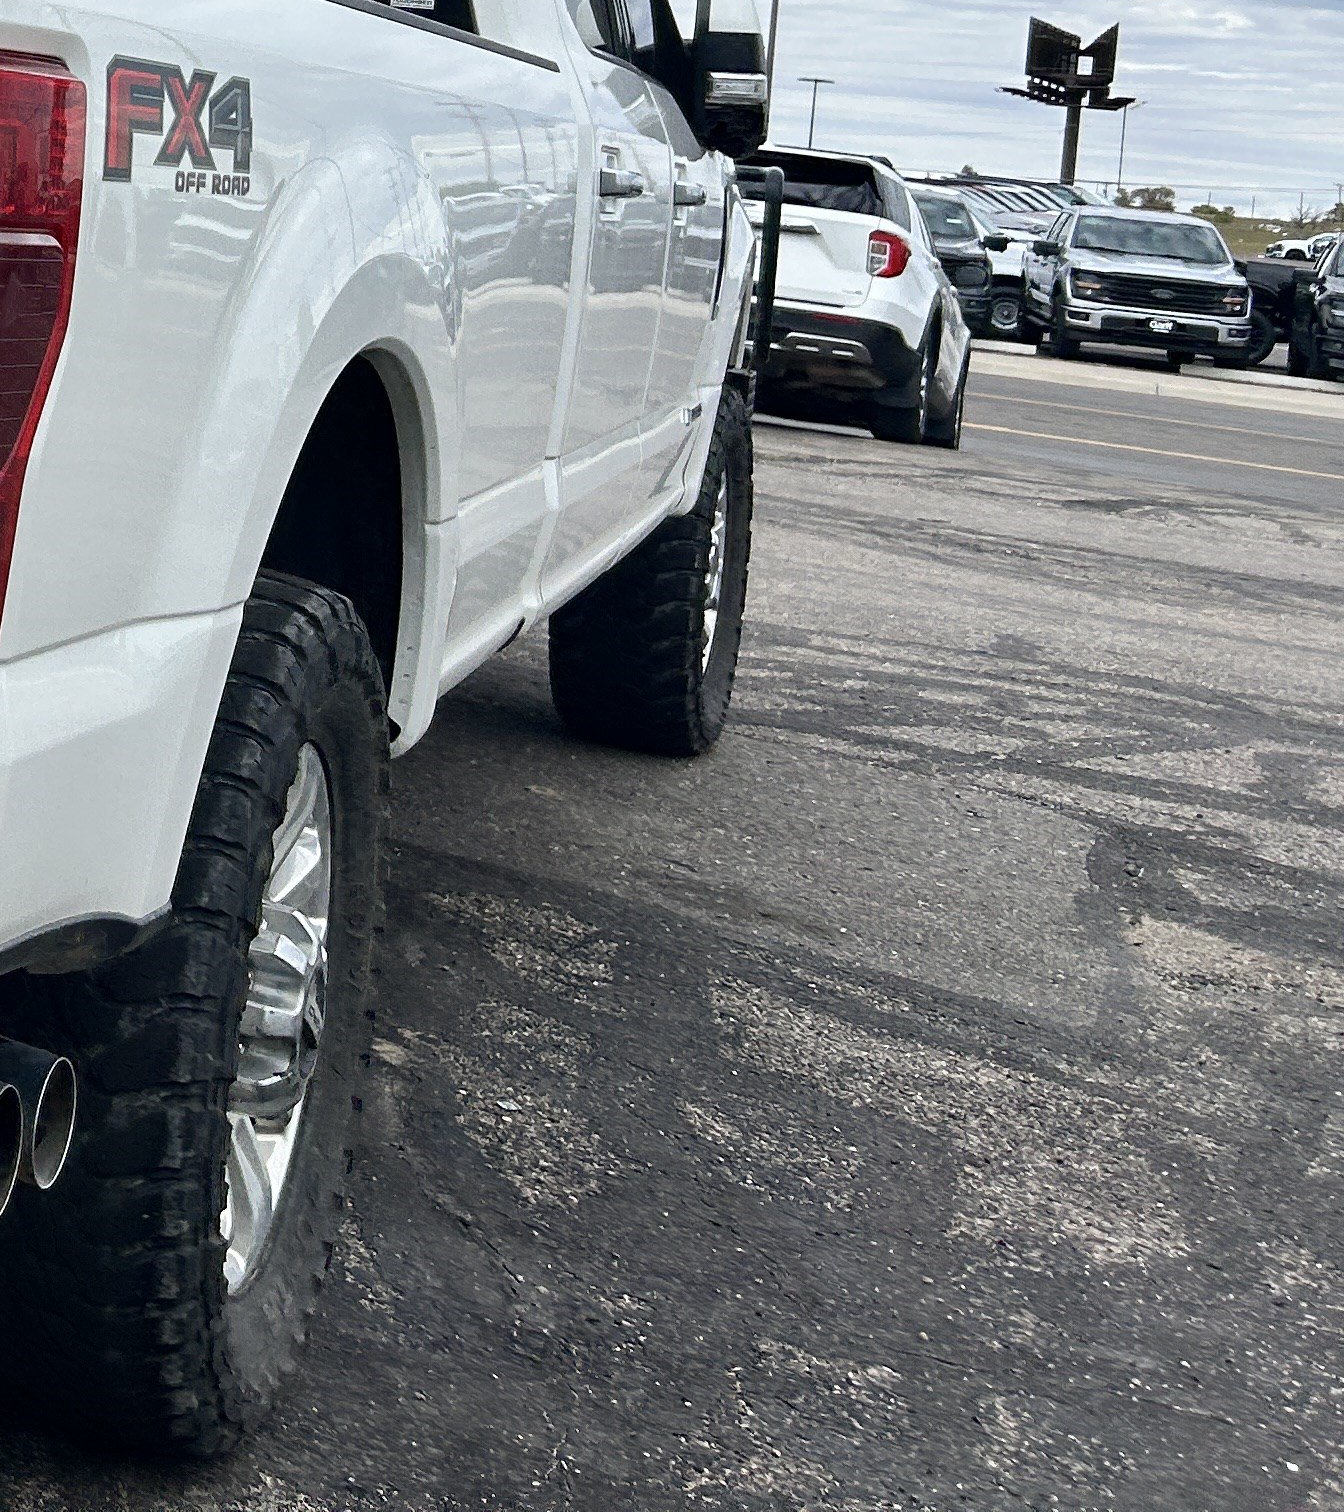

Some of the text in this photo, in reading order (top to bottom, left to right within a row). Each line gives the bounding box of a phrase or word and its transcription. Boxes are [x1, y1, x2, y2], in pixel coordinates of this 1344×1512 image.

[102, 54, 252, 181] FX4
[175, 170, 250, 196] OFF ROAD
